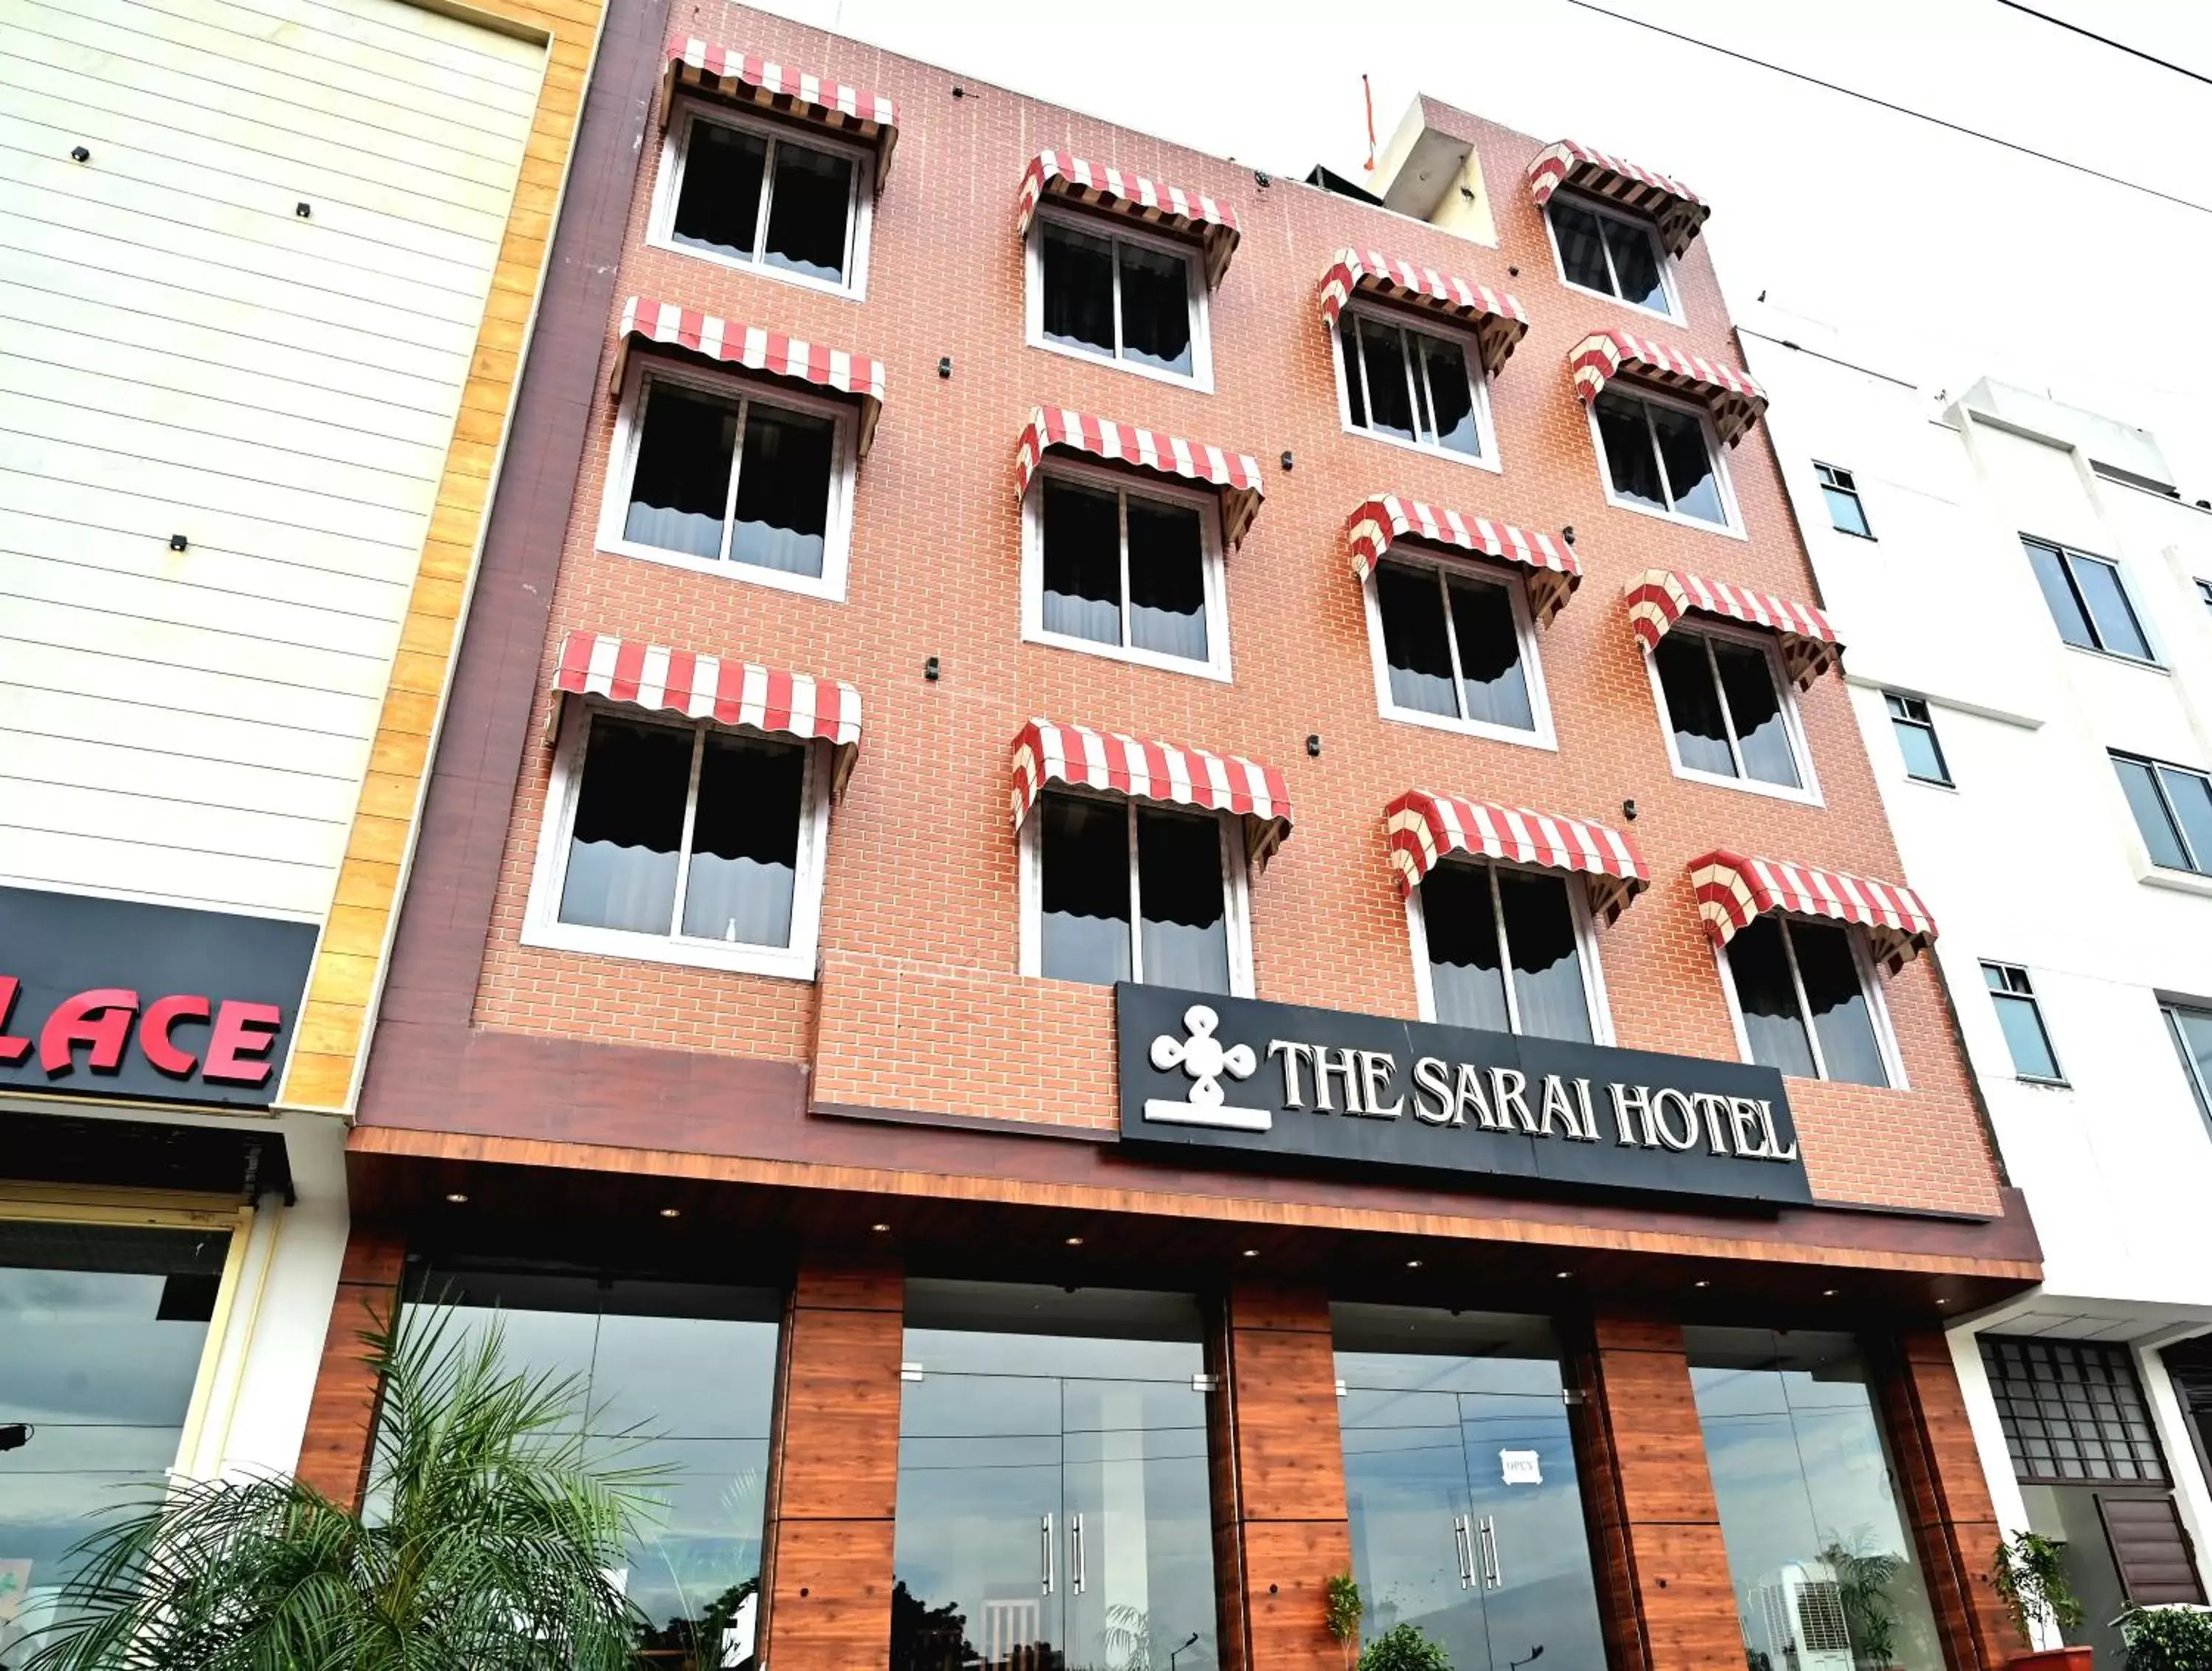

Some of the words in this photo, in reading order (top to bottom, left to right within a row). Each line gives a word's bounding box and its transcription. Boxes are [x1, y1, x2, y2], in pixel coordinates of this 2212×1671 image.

[1267, 1038, 1405, 1119] THE
[1413, 1057, 1602, 1141] SARAI
[1605, 1082, 1797, 1161] HOTEL
[1506, 1460, 1534, 1471] OPEN
